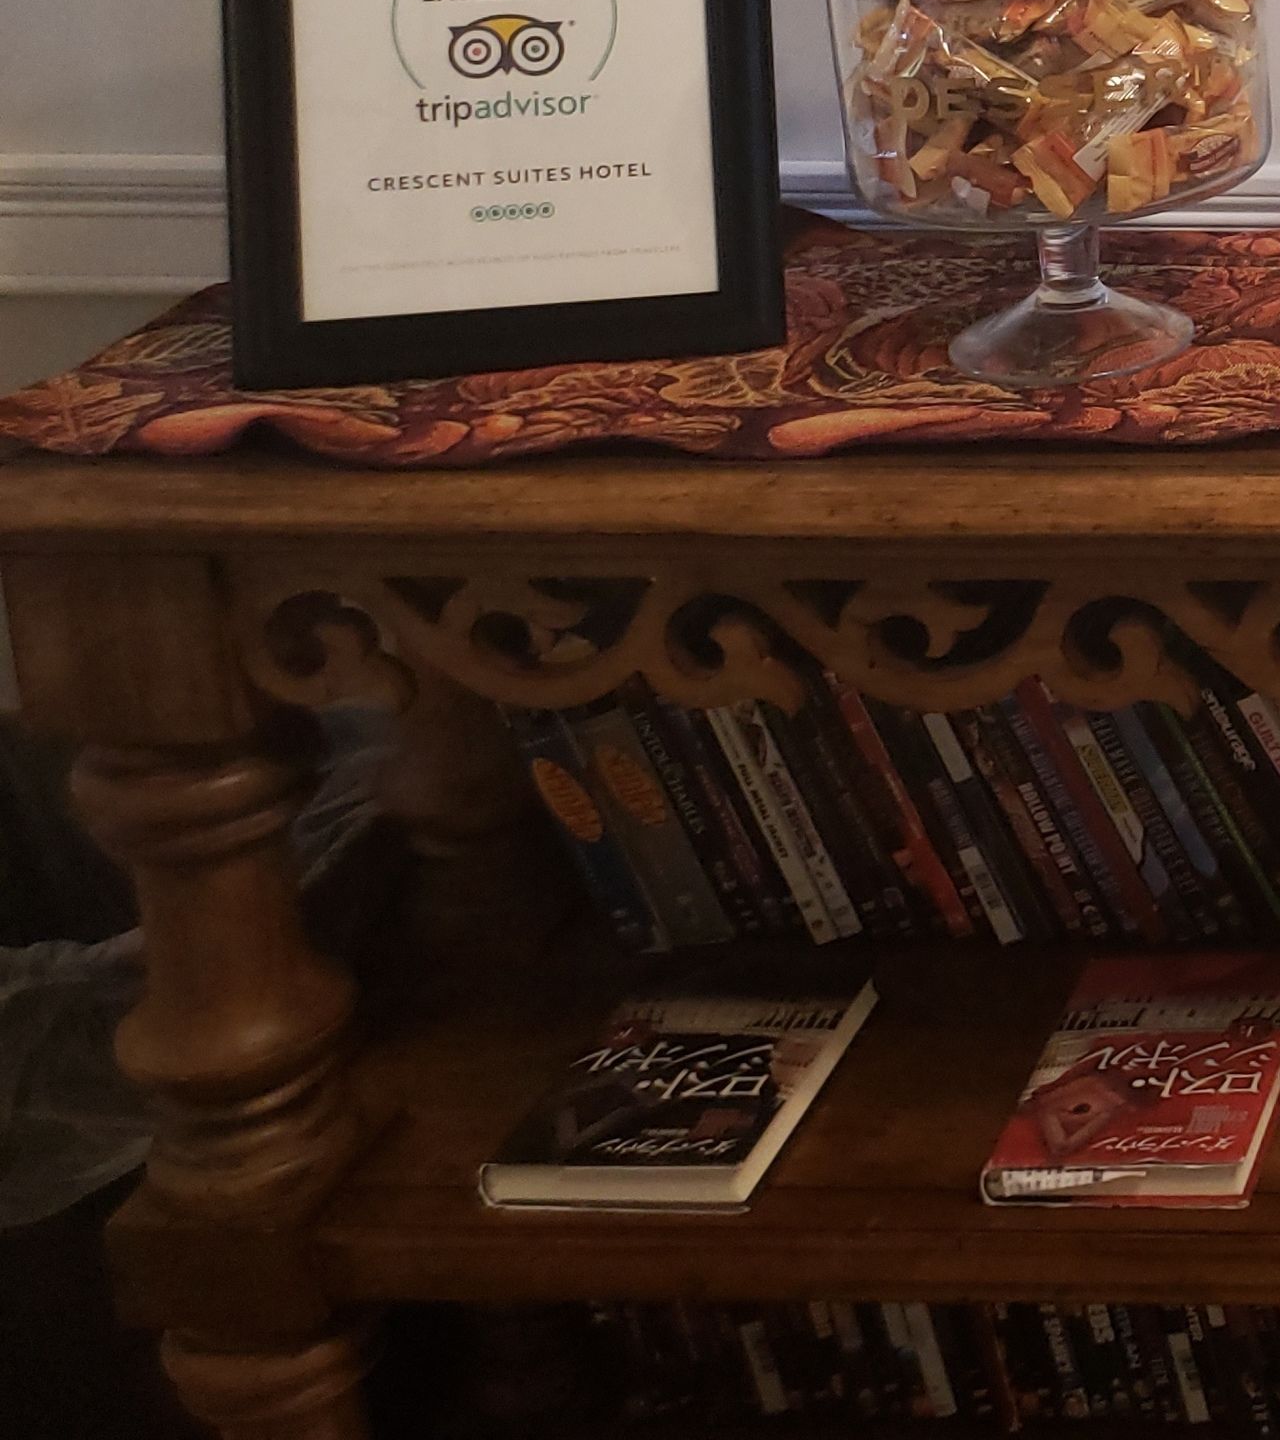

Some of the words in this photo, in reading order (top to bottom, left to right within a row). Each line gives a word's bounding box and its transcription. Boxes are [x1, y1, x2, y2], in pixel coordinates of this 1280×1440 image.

[415, 90, 592, 128] tripadvisor
[367, 171, 486, 192] CRESCENT
[492, 166, 571, 186] SUITES
[579, 162, 652, 180] HOTEL
[736, 762, 754, 787] FULL
[748, 787, 771, 821] METAL
[1016, 779, 1058, 838] HOLLOW
